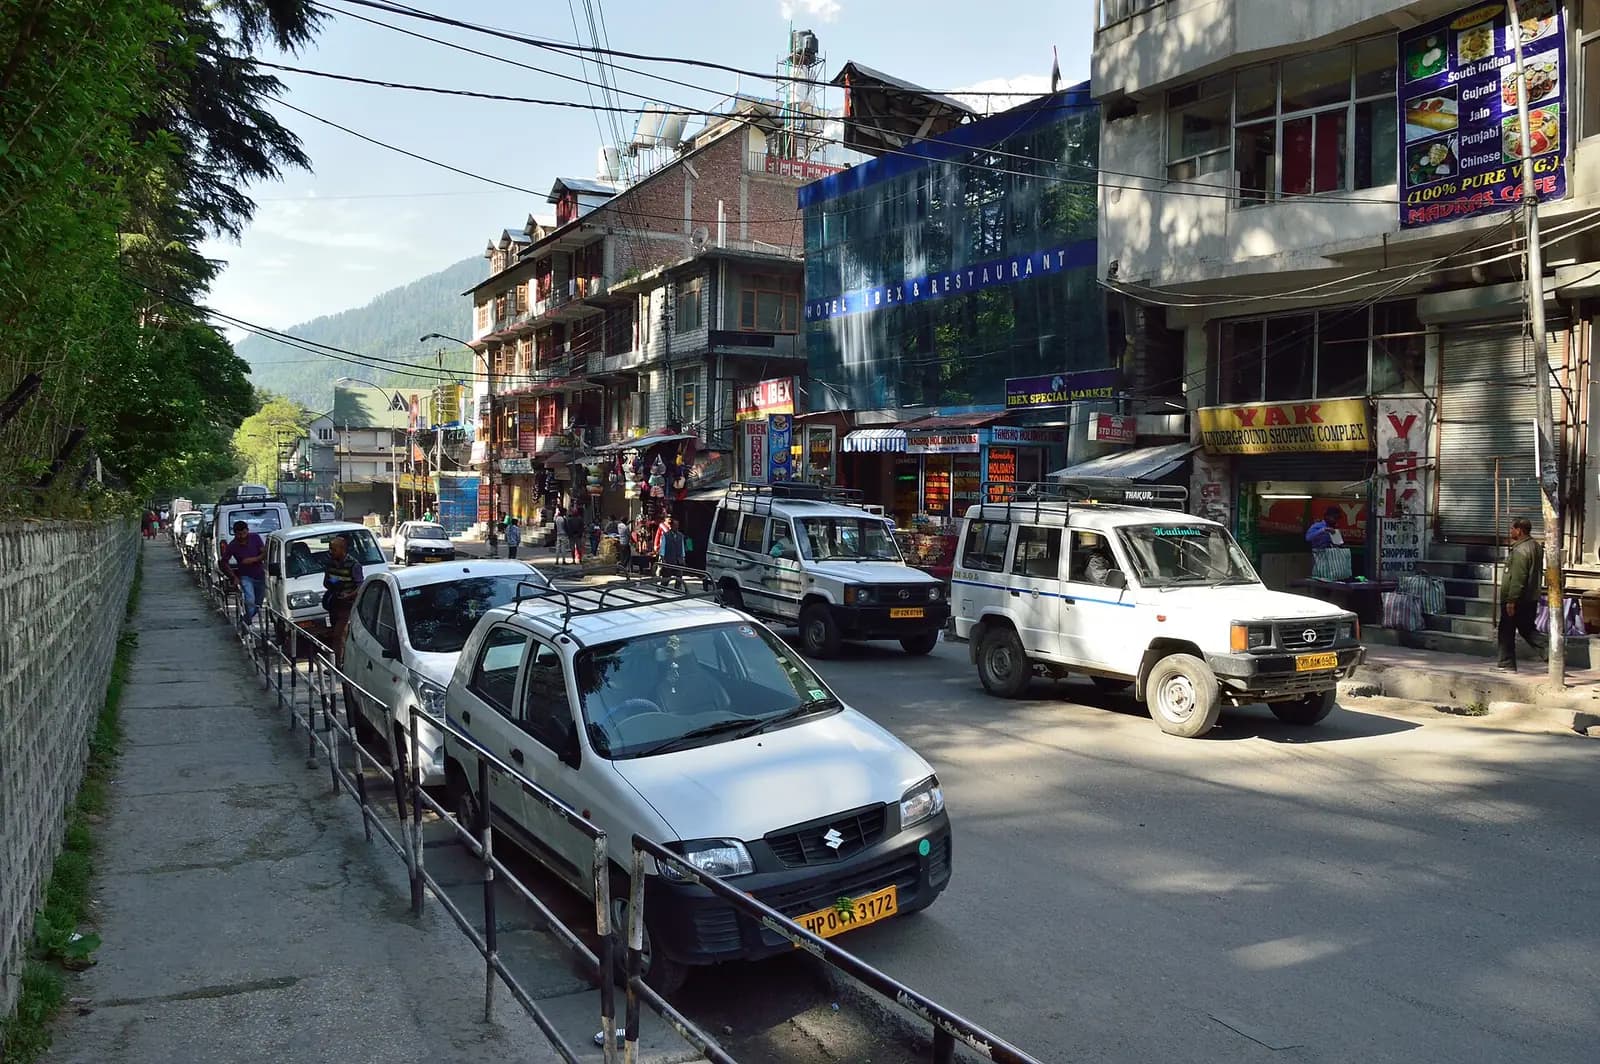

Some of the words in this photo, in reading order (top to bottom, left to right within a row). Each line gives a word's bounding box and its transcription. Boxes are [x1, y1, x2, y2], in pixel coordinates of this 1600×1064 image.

[1447, 66, 1477, 83] South
[1478, 54, 1511, 73] Indian
[1462, 81, 1497, 101] Gujrati
[1469, 107, 1490, 122] Jain
[1461, 126, 1499, 147] Punjabi
[1460, 151, 1500, 169] Chinese
[1407, 183, 1457, 206] (100%
[1461, 169, 1506, 191] PURE
[1512, 155, 1560, 179] VG.)
[1408, 190, 1495, 224] MADRAS
[807, 298, 847, 318] HOTEL
[865, 286, 903, 307] IBEX
[913, 282, 919, 297] &
[931, 250, 1065, 292] RESTAURANT
[767, 380, 792, 405] IBEX
[1008, 394, 1029, 405] IBEX
[1029, 391, 1069, 404] SPECIAL
[1071, 387, 1113, 400] MARKET
[1233, 404, 1325, 427] YAK
[929, 435, 957, 446] HOLIDAYS
[957, 434, 977, 444] TOURS
[1203, 427, 1268, 447] UNDERGROUND
[1269, 425, 1315, 444] SHOPPING
[1317, 423, 1366, 442] COMPLEX
[989, 463, 1015, 474] HOLIDAYS
[1125, 491, 1154, 501] THAKUR
